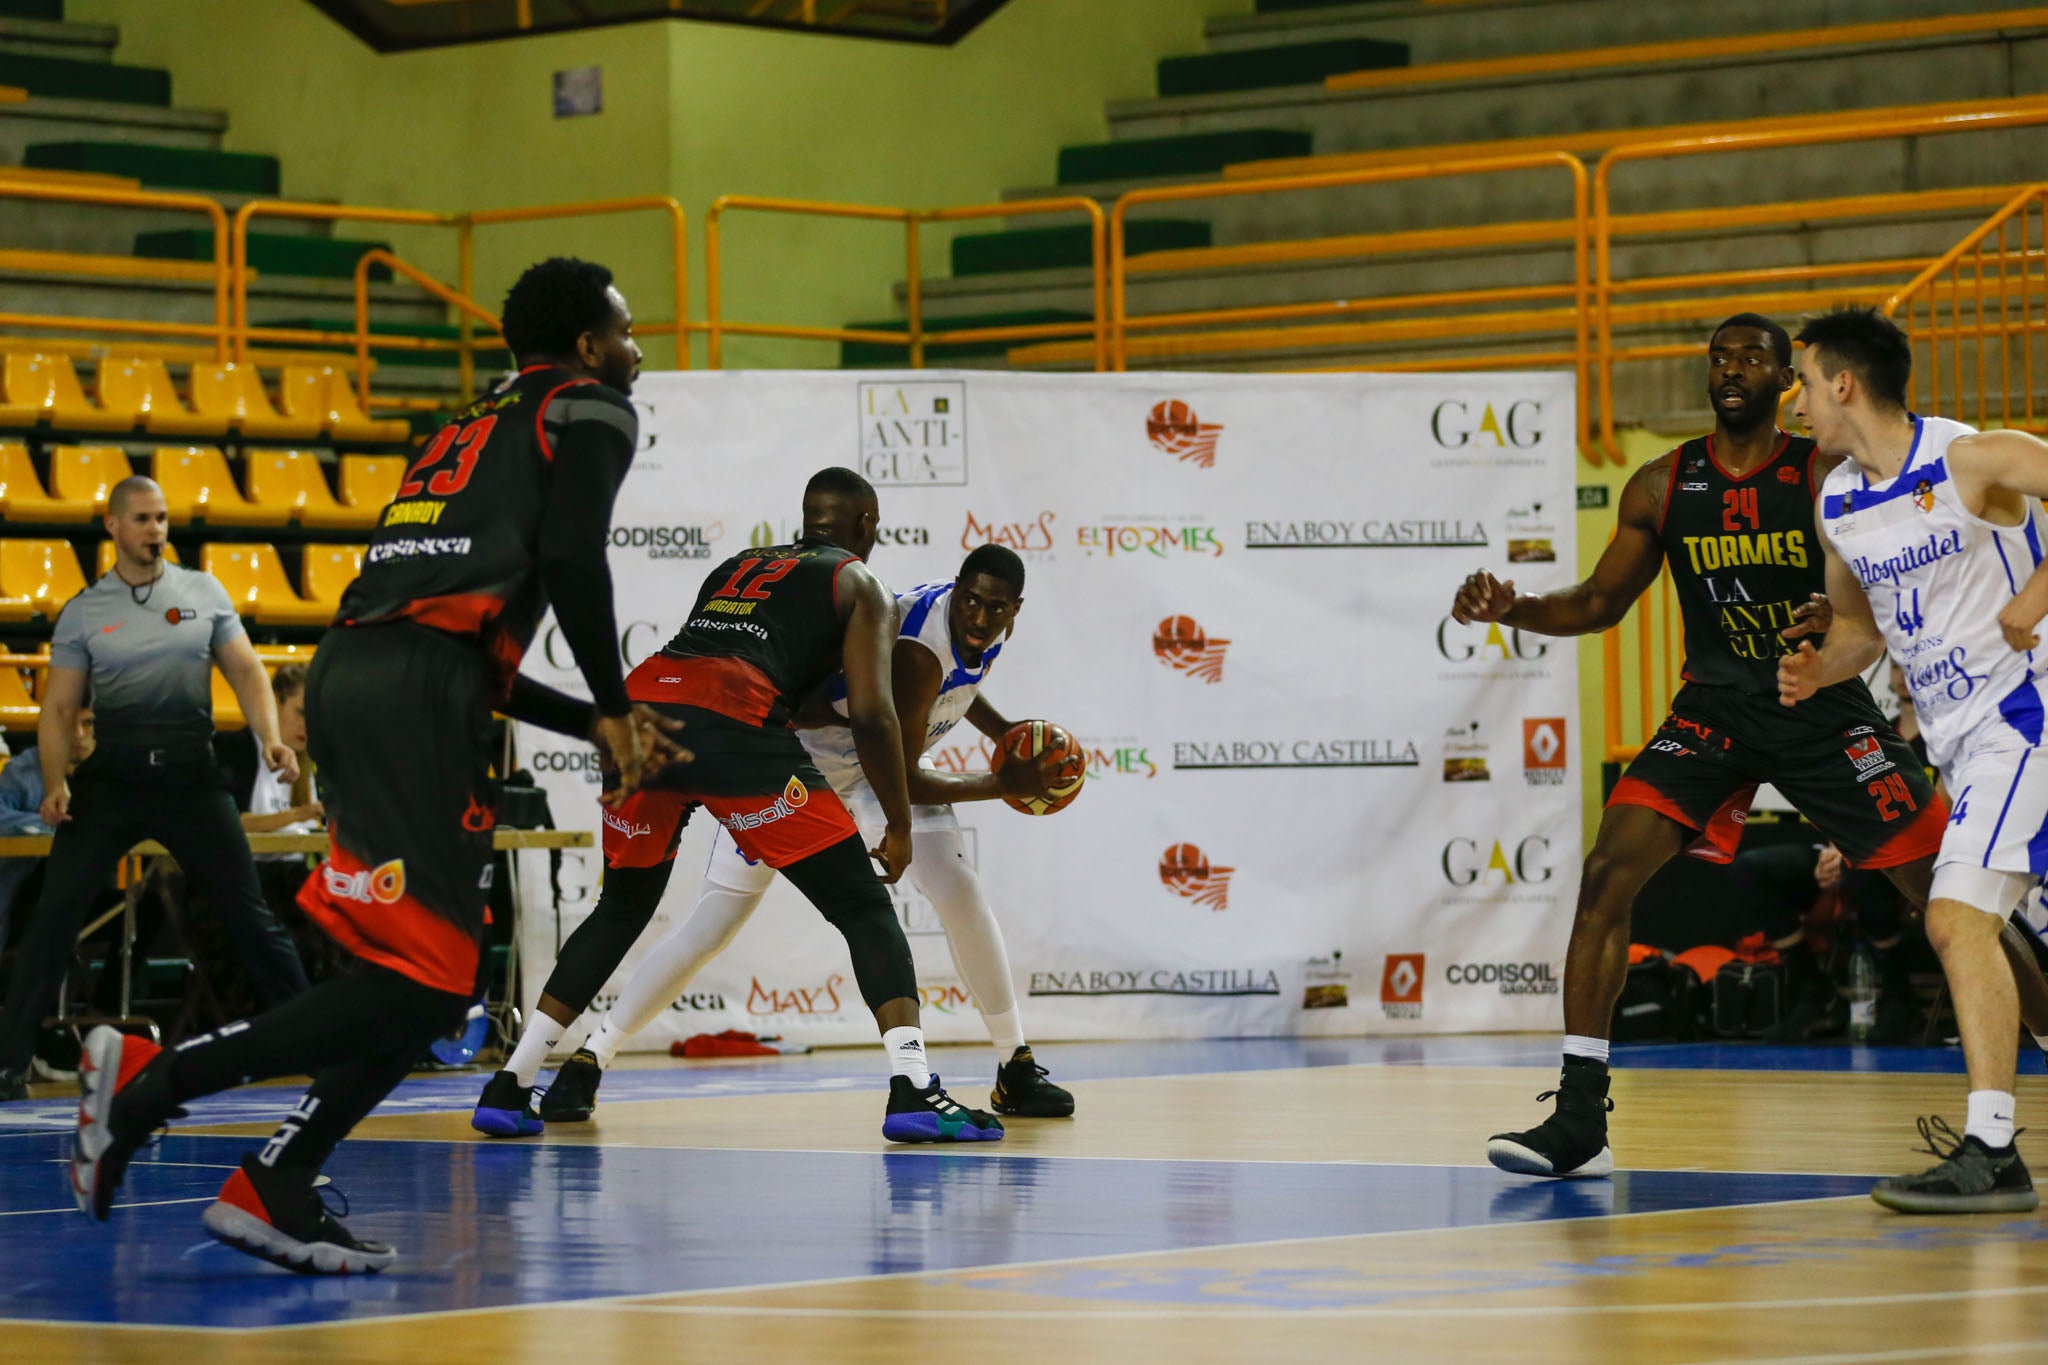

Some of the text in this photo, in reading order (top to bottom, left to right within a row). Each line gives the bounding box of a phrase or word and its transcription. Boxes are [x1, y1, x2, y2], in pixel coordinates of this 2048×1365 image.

[1431, 399, 1543, 448] GAG
[399, 414, 498, 498] 23
[1722, 487, 1760, 531] 24
[1246, 520, 1488, 544] ENABOY CASTILLA
[1683, 529, 1809, 575] TORMES
[711, 558, 800, 600] 12
[1704, 577, 1753, 603] LA
[1721, 600, 1798, 632] ANTI
[1173, 742, 1284, 764] ENABOY
[1292, 740, 1419, 762] CASTILLA
[1867, 772, 1917, 822] 24
[1442, 836, 1552, 888] GAG
[1030, 970, 1279, 992] ENABOY CASTILLA
[1446, 963, 1558, 984] CODISOIL
